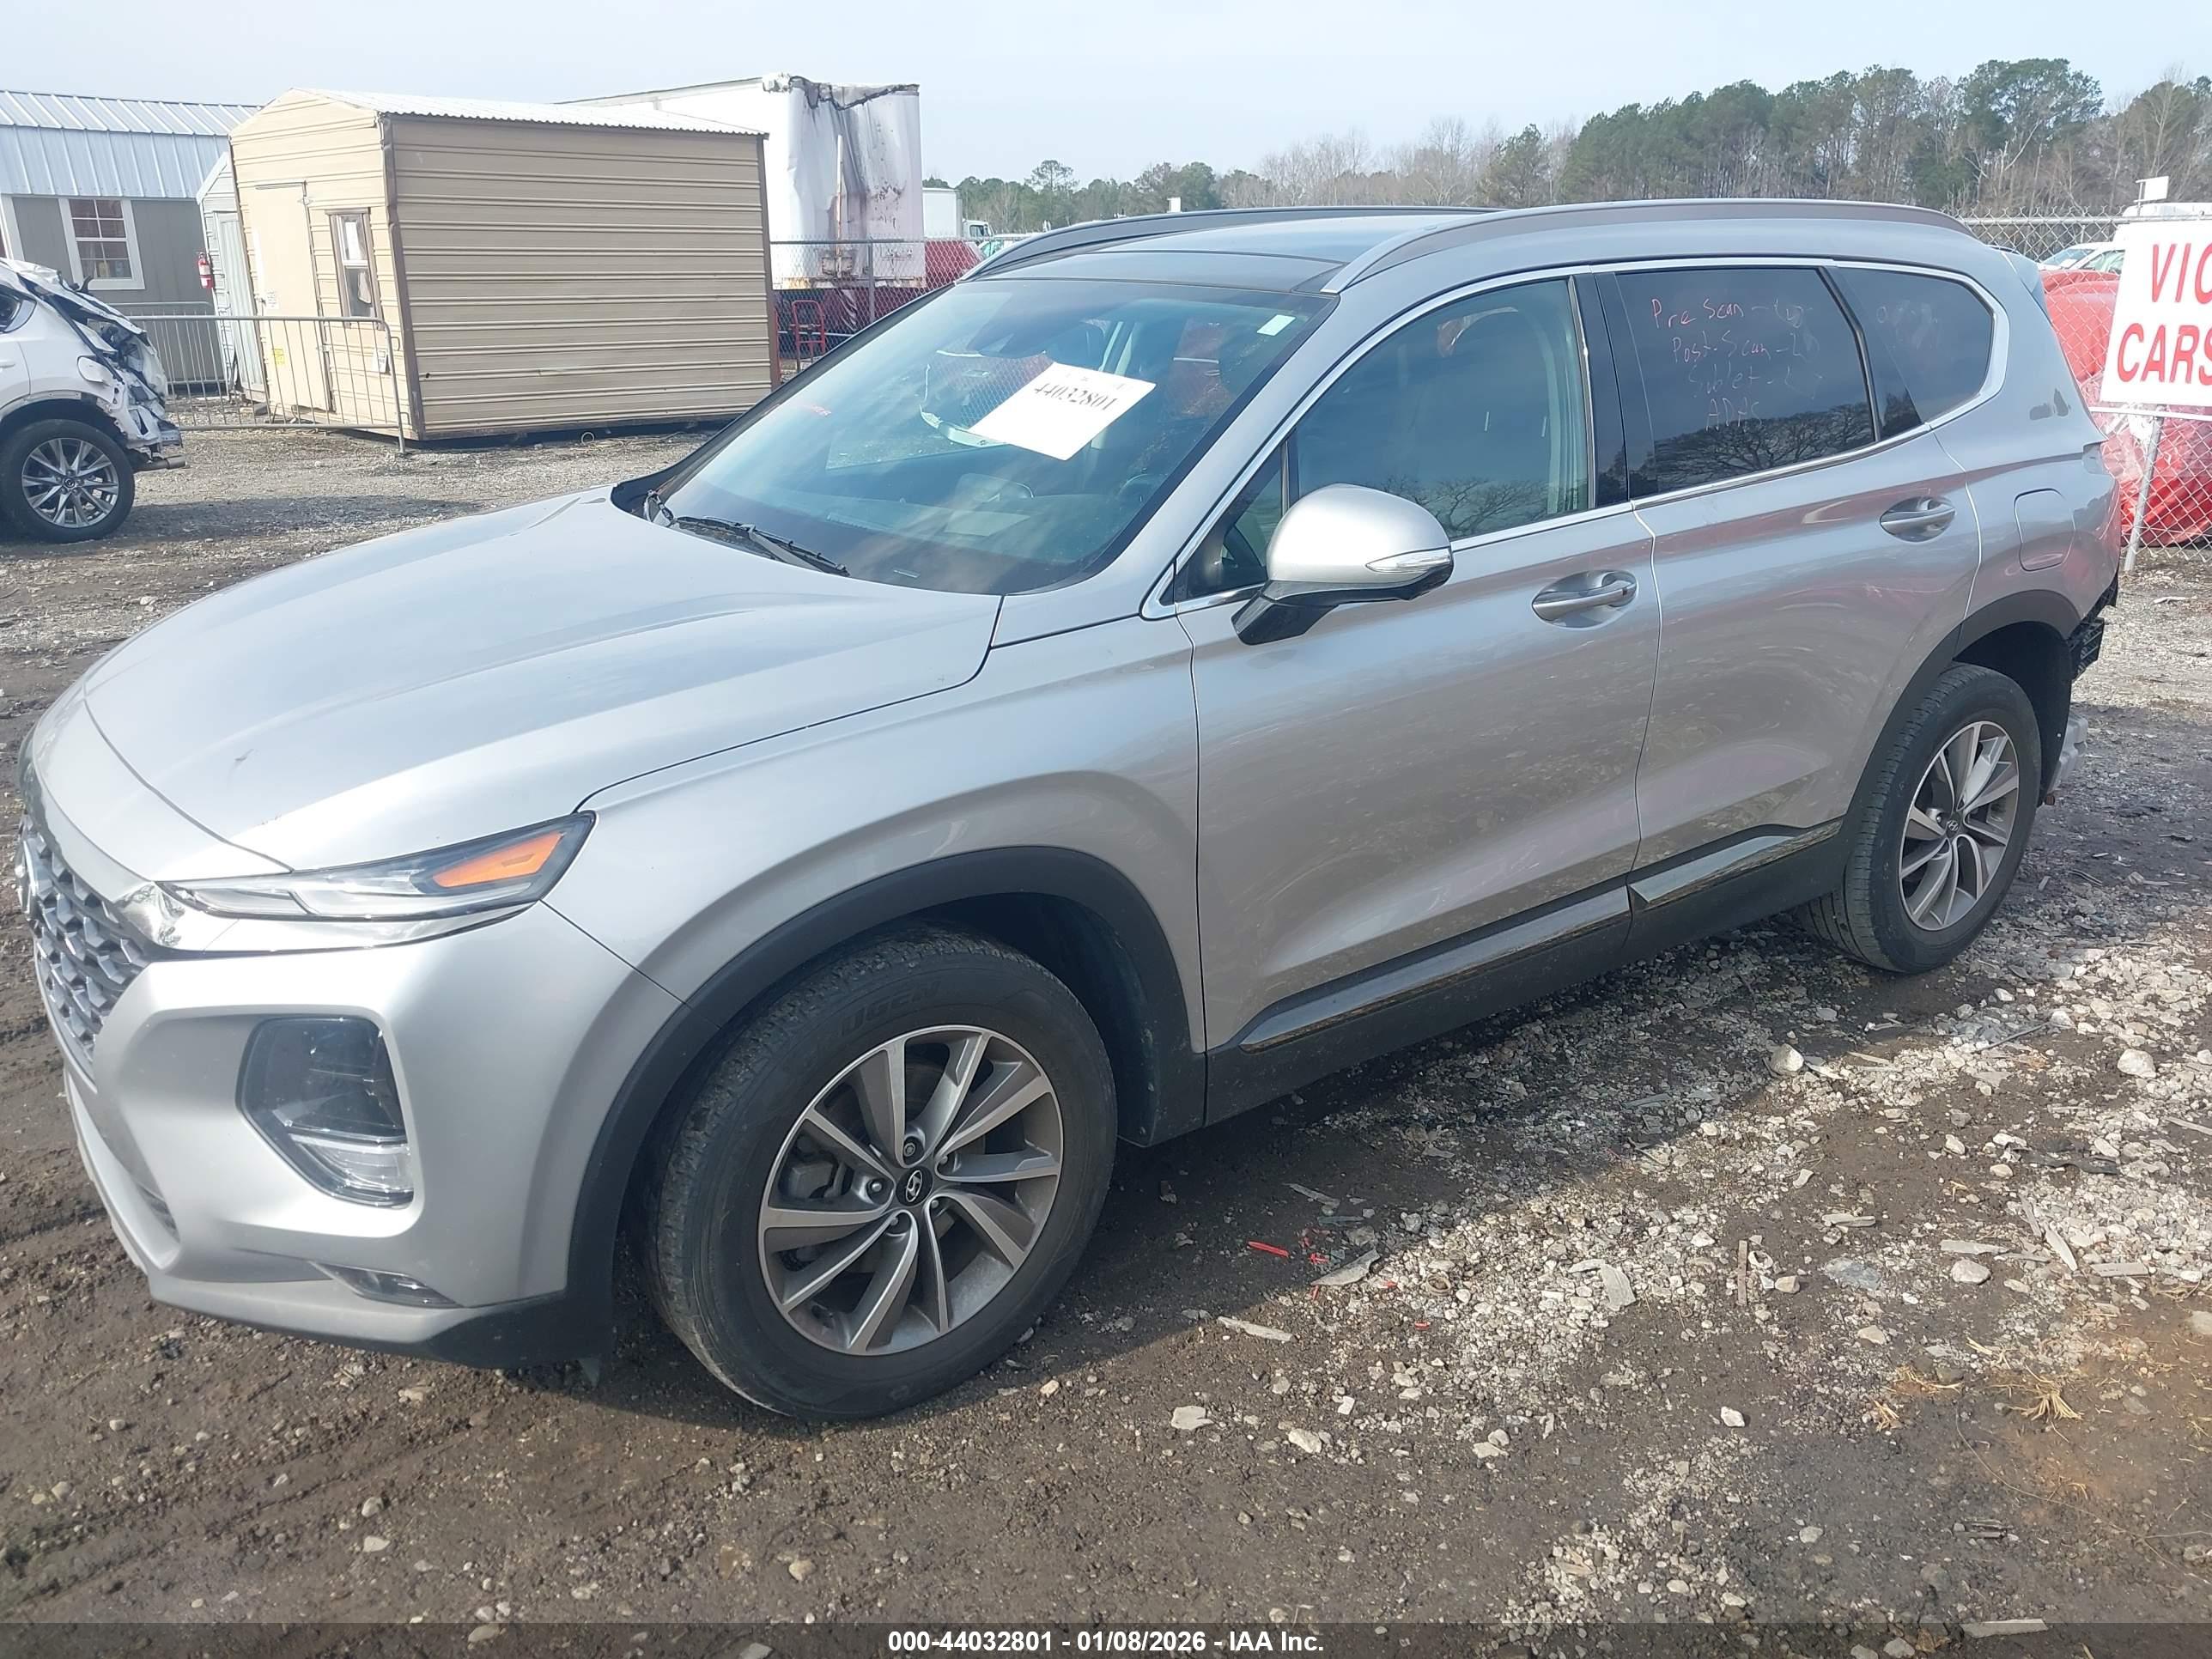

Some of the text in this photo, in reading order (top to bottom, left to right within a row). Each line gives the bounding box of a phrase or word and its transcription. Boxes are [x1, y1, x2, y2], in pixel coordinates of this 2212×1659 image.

[1651, 298, 1697, 329] Pre
[1703, 298, 1745, 320] Scan
[1034, 383, 1118, 410] 44032801
